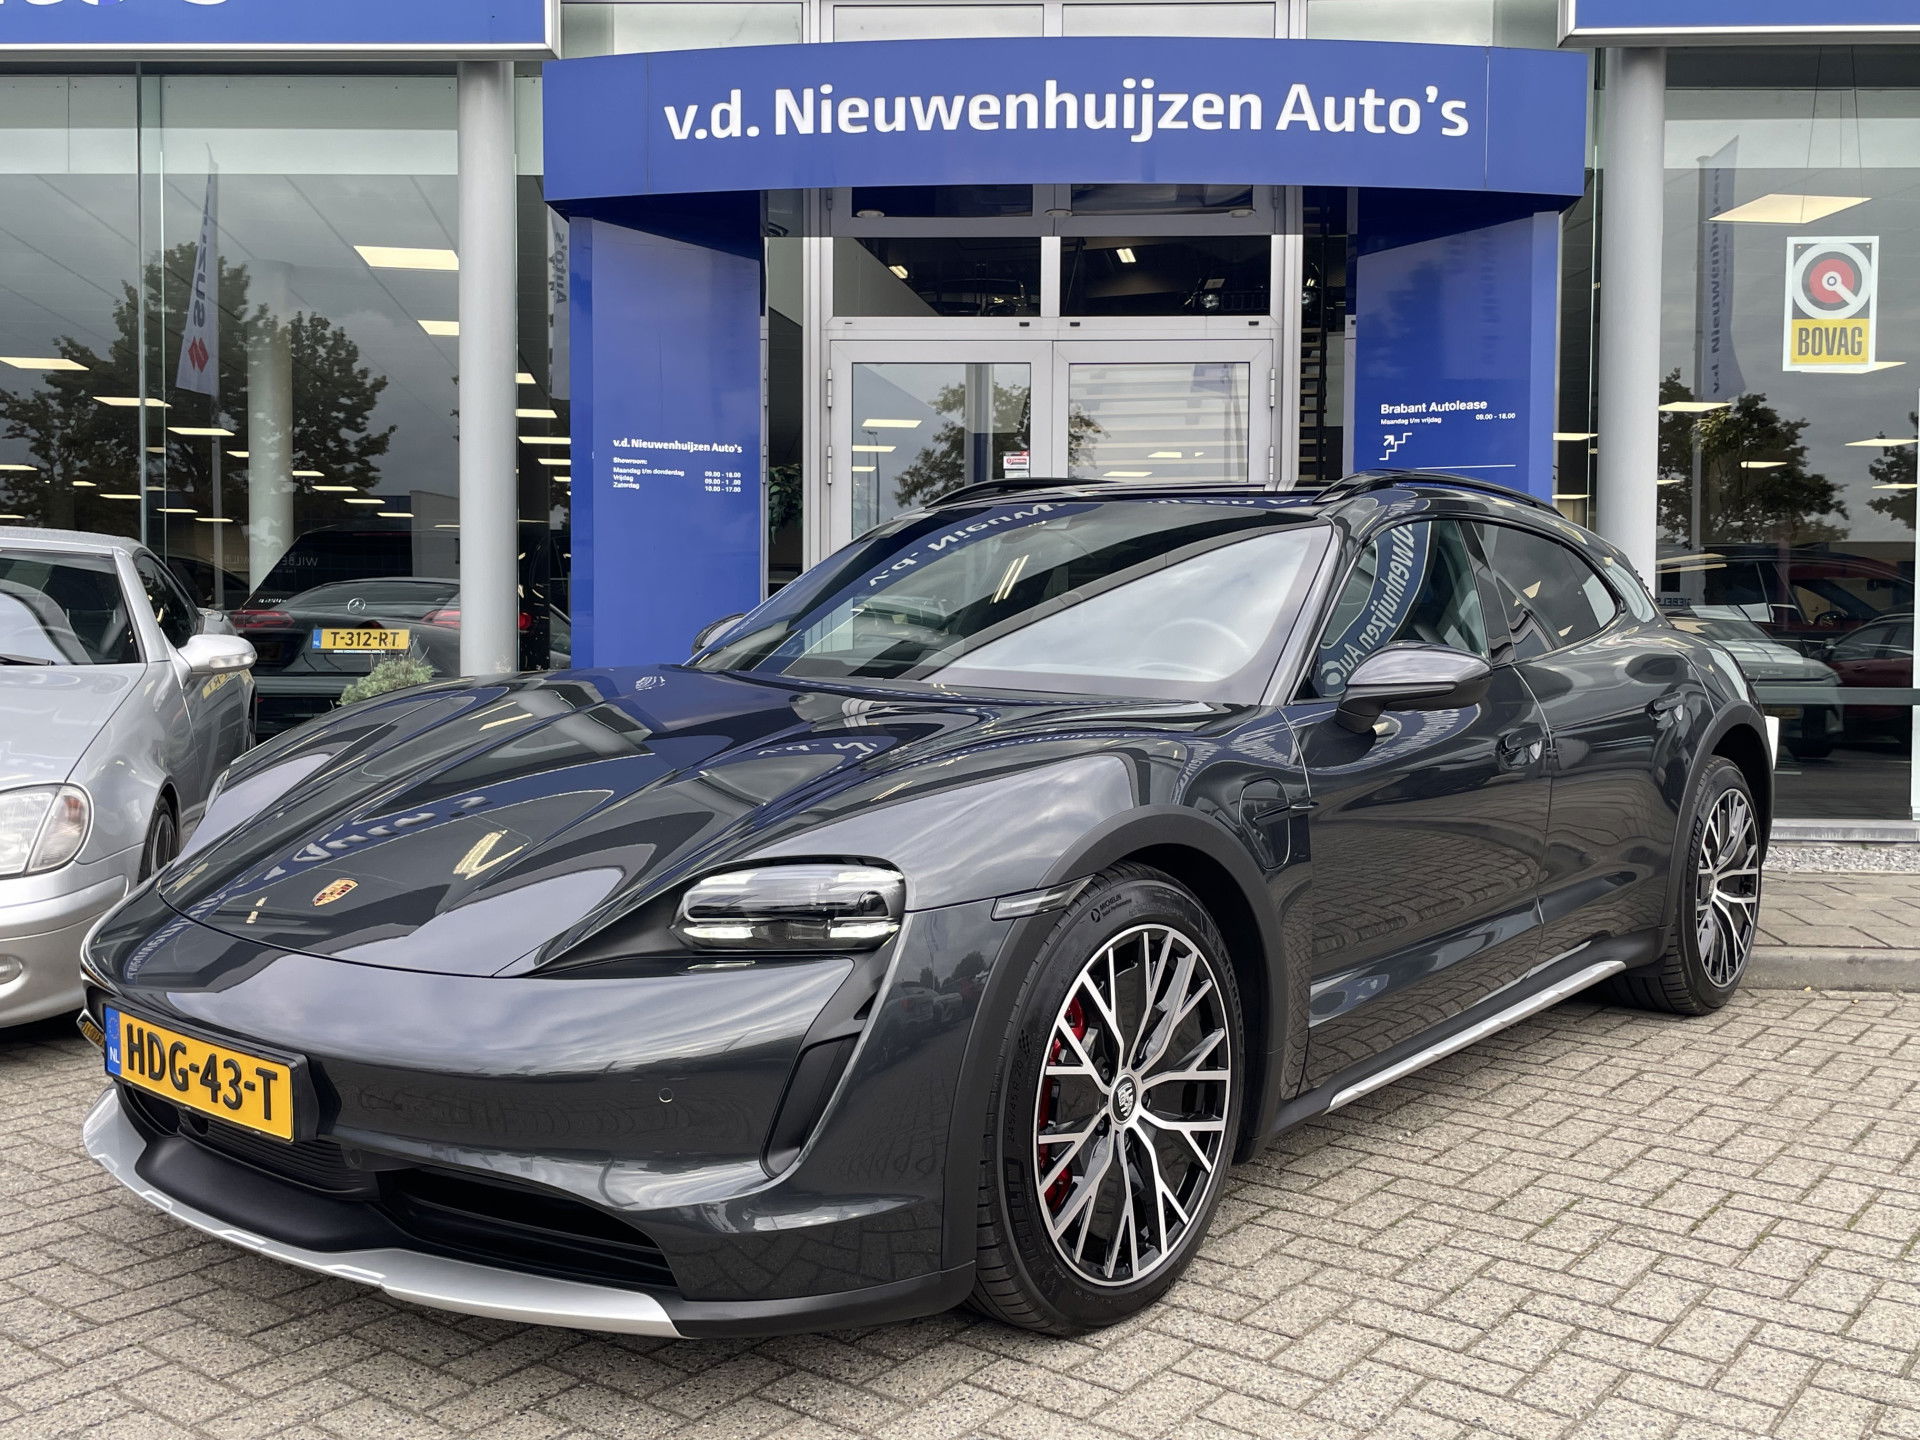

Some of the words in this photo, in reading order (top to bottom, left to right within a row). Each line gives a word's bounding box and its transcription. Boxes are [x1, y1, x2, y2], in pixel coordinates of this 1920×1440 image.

[663, 88, 760, 141] v.d.
[774, 77, 1262, 143] Nieuwenhuijzen
[1275, 83, 1470, 137] Auto's
[1797, 326, 1863, 356] BOVAG
[1380, 402, 1426, 414] Brabant
[1428, 400, 1488, 412] Autolease
[1421, 416, 1442, 424] vrijdag
[613, 437, 630, 448] v.d.
[631, 439, 710, 453] Nieuwenhuijzen
[711, 442, 743, 453] Auto's
[613, 467, 641, 475] Maandag
[652, 469, 685, 477] donderdag
[613, 474, 634, 482] Vrijdag
[330, 631, 400, 647] T-312-RT
[109, 1046, 120, 1065] NL
[126, 1022, 278, 1121] HDG-43-T
